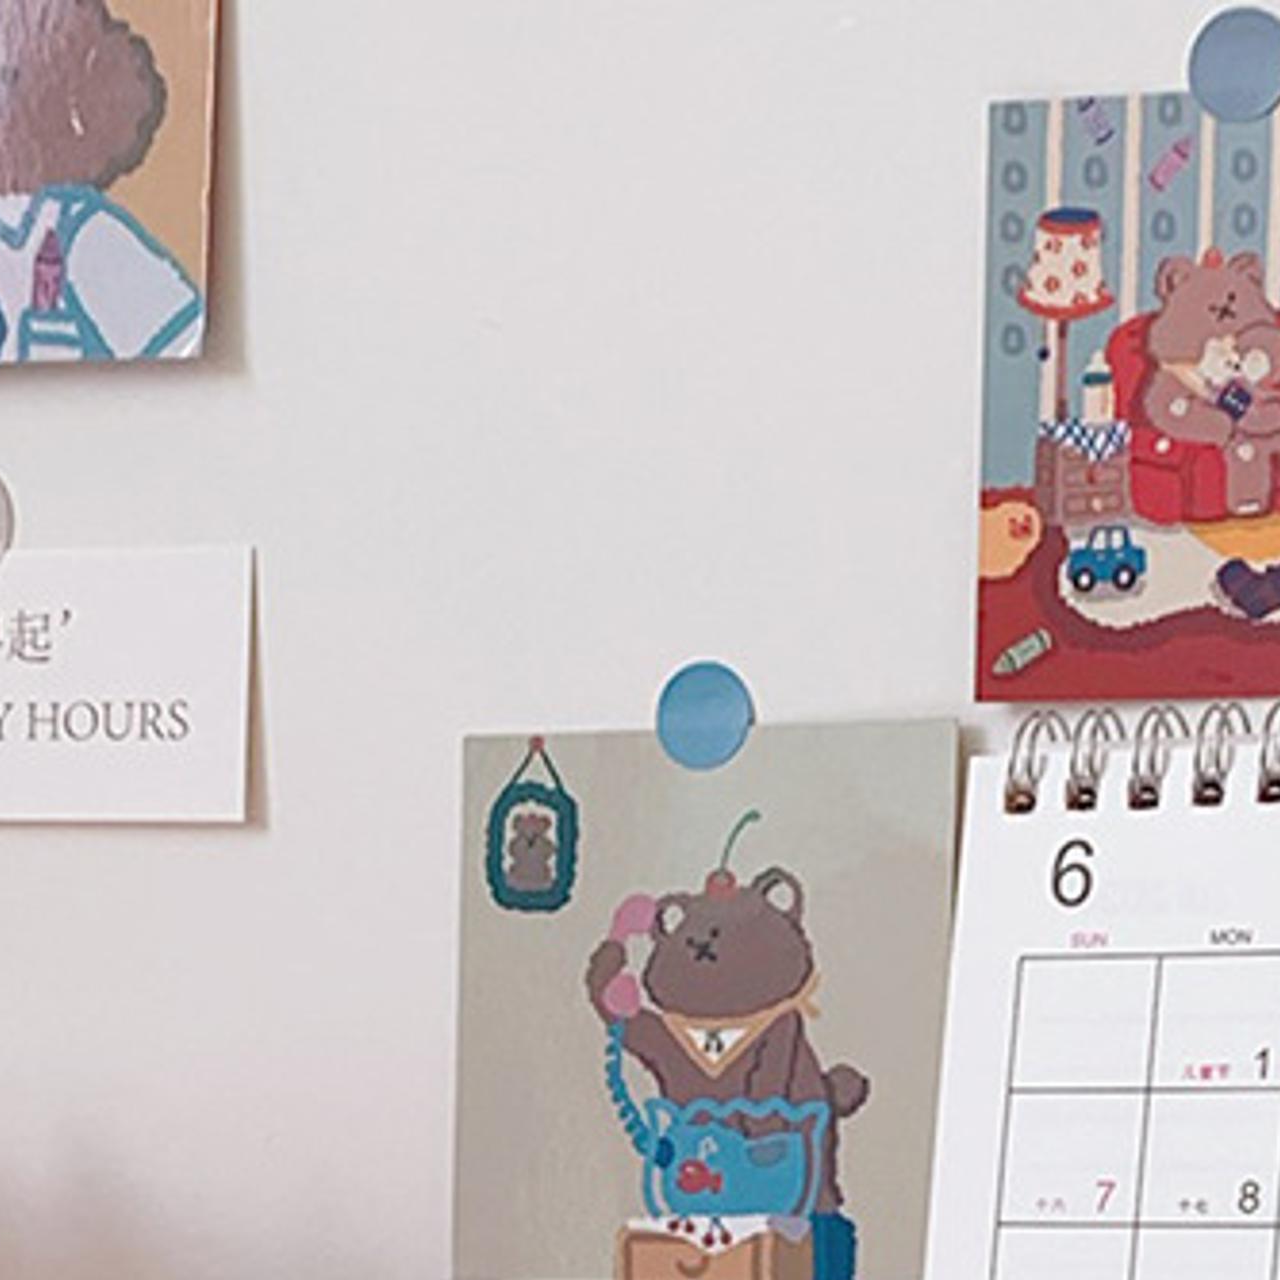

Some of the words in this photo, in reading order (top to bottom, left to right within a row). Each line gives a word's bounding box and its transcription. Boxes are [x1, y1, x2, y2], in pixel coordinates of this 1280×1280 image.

[27, 699, 190, 742] HOURS
[1051, 839, 1094, 908] 6
[1071, 932, 1109, 949] SUN
[1210, 928, 1253, 946] MON
[1256, 1048, 1270, 1079] 1
[1096, 1180, 1117, 1213] 7
[1237, 1179, 1261, 1215] 8
